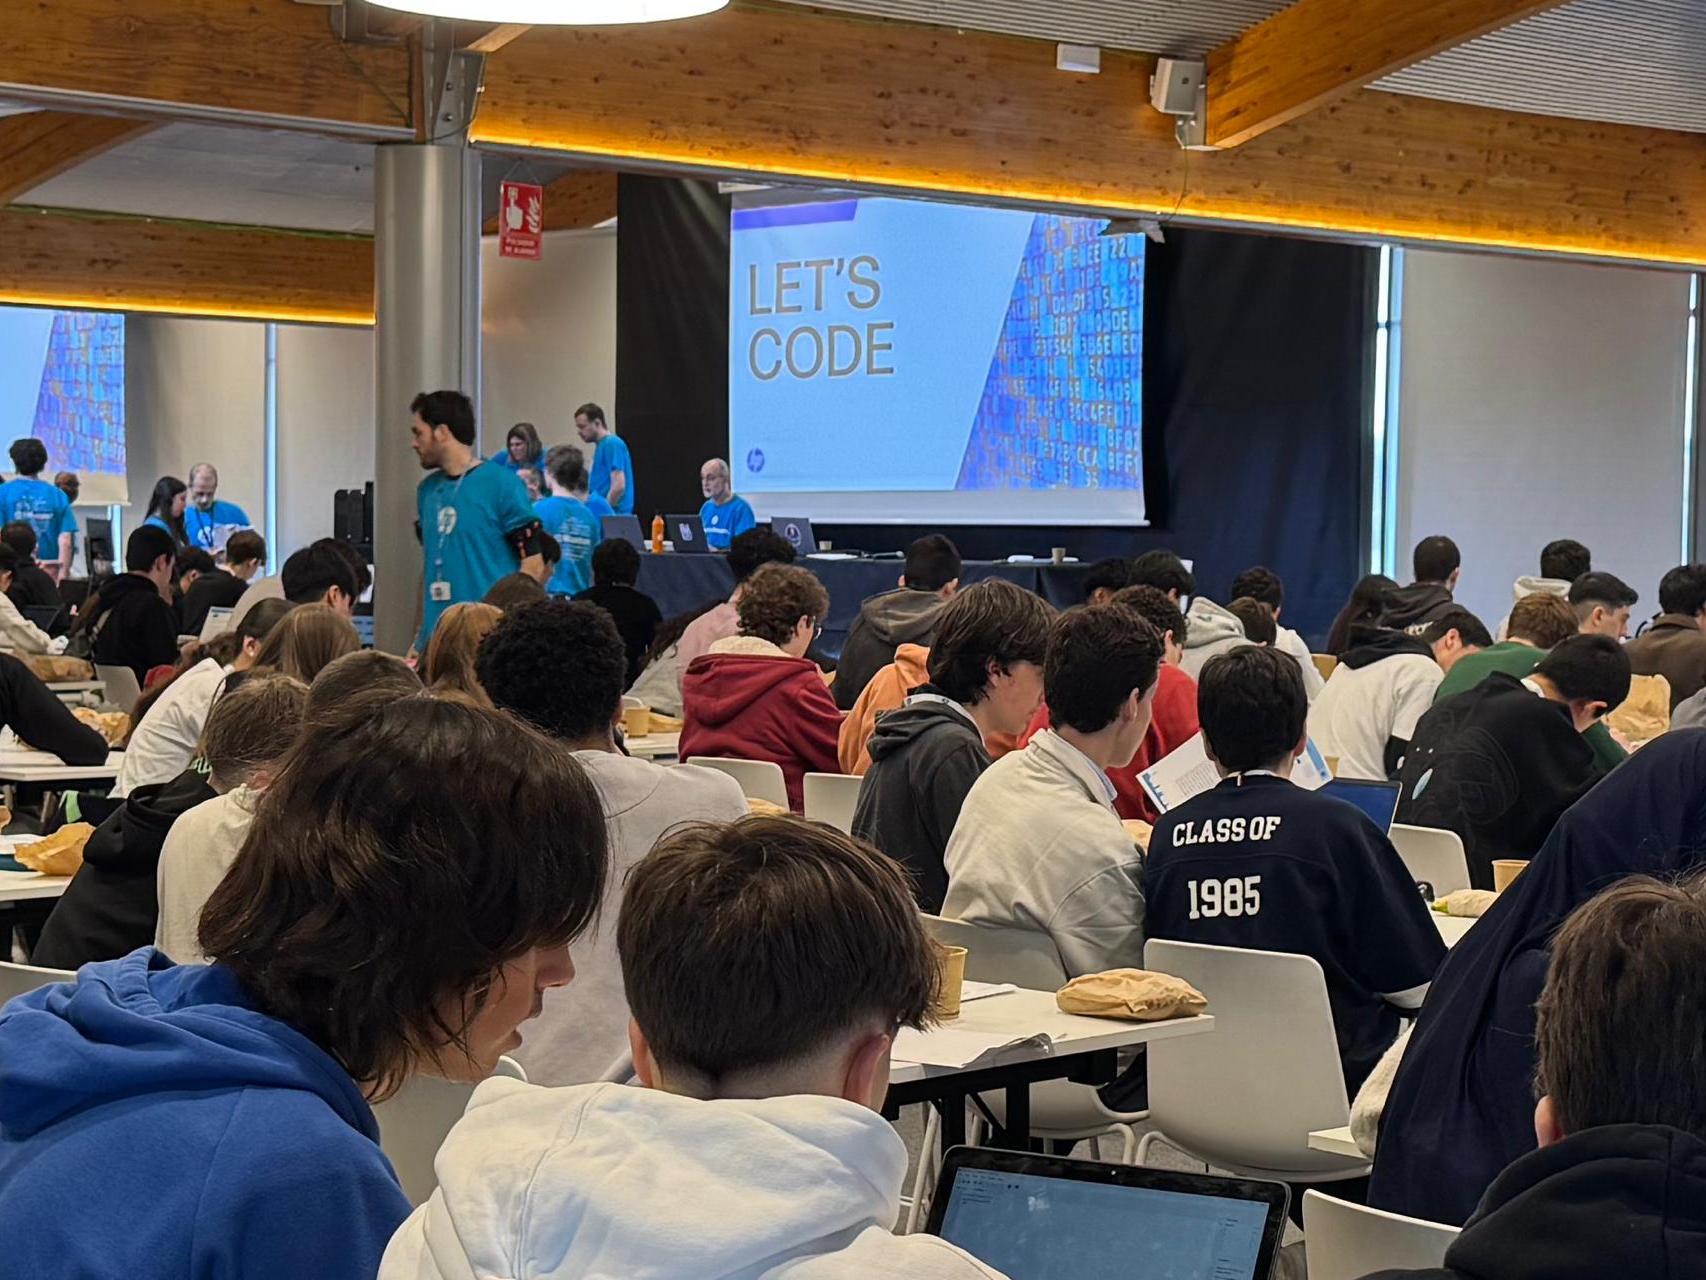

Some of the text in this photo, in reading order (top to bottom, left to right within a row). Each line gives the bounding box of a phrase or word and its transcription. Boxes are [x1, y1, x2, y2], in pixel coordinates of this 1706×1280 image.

[749, 255, 881, 316] LET'S
[748, 322, 895, 381] CODE
[1171, 815, 1282, 848] CLASS OF
[1187, 874, 1263, 920] 1985
